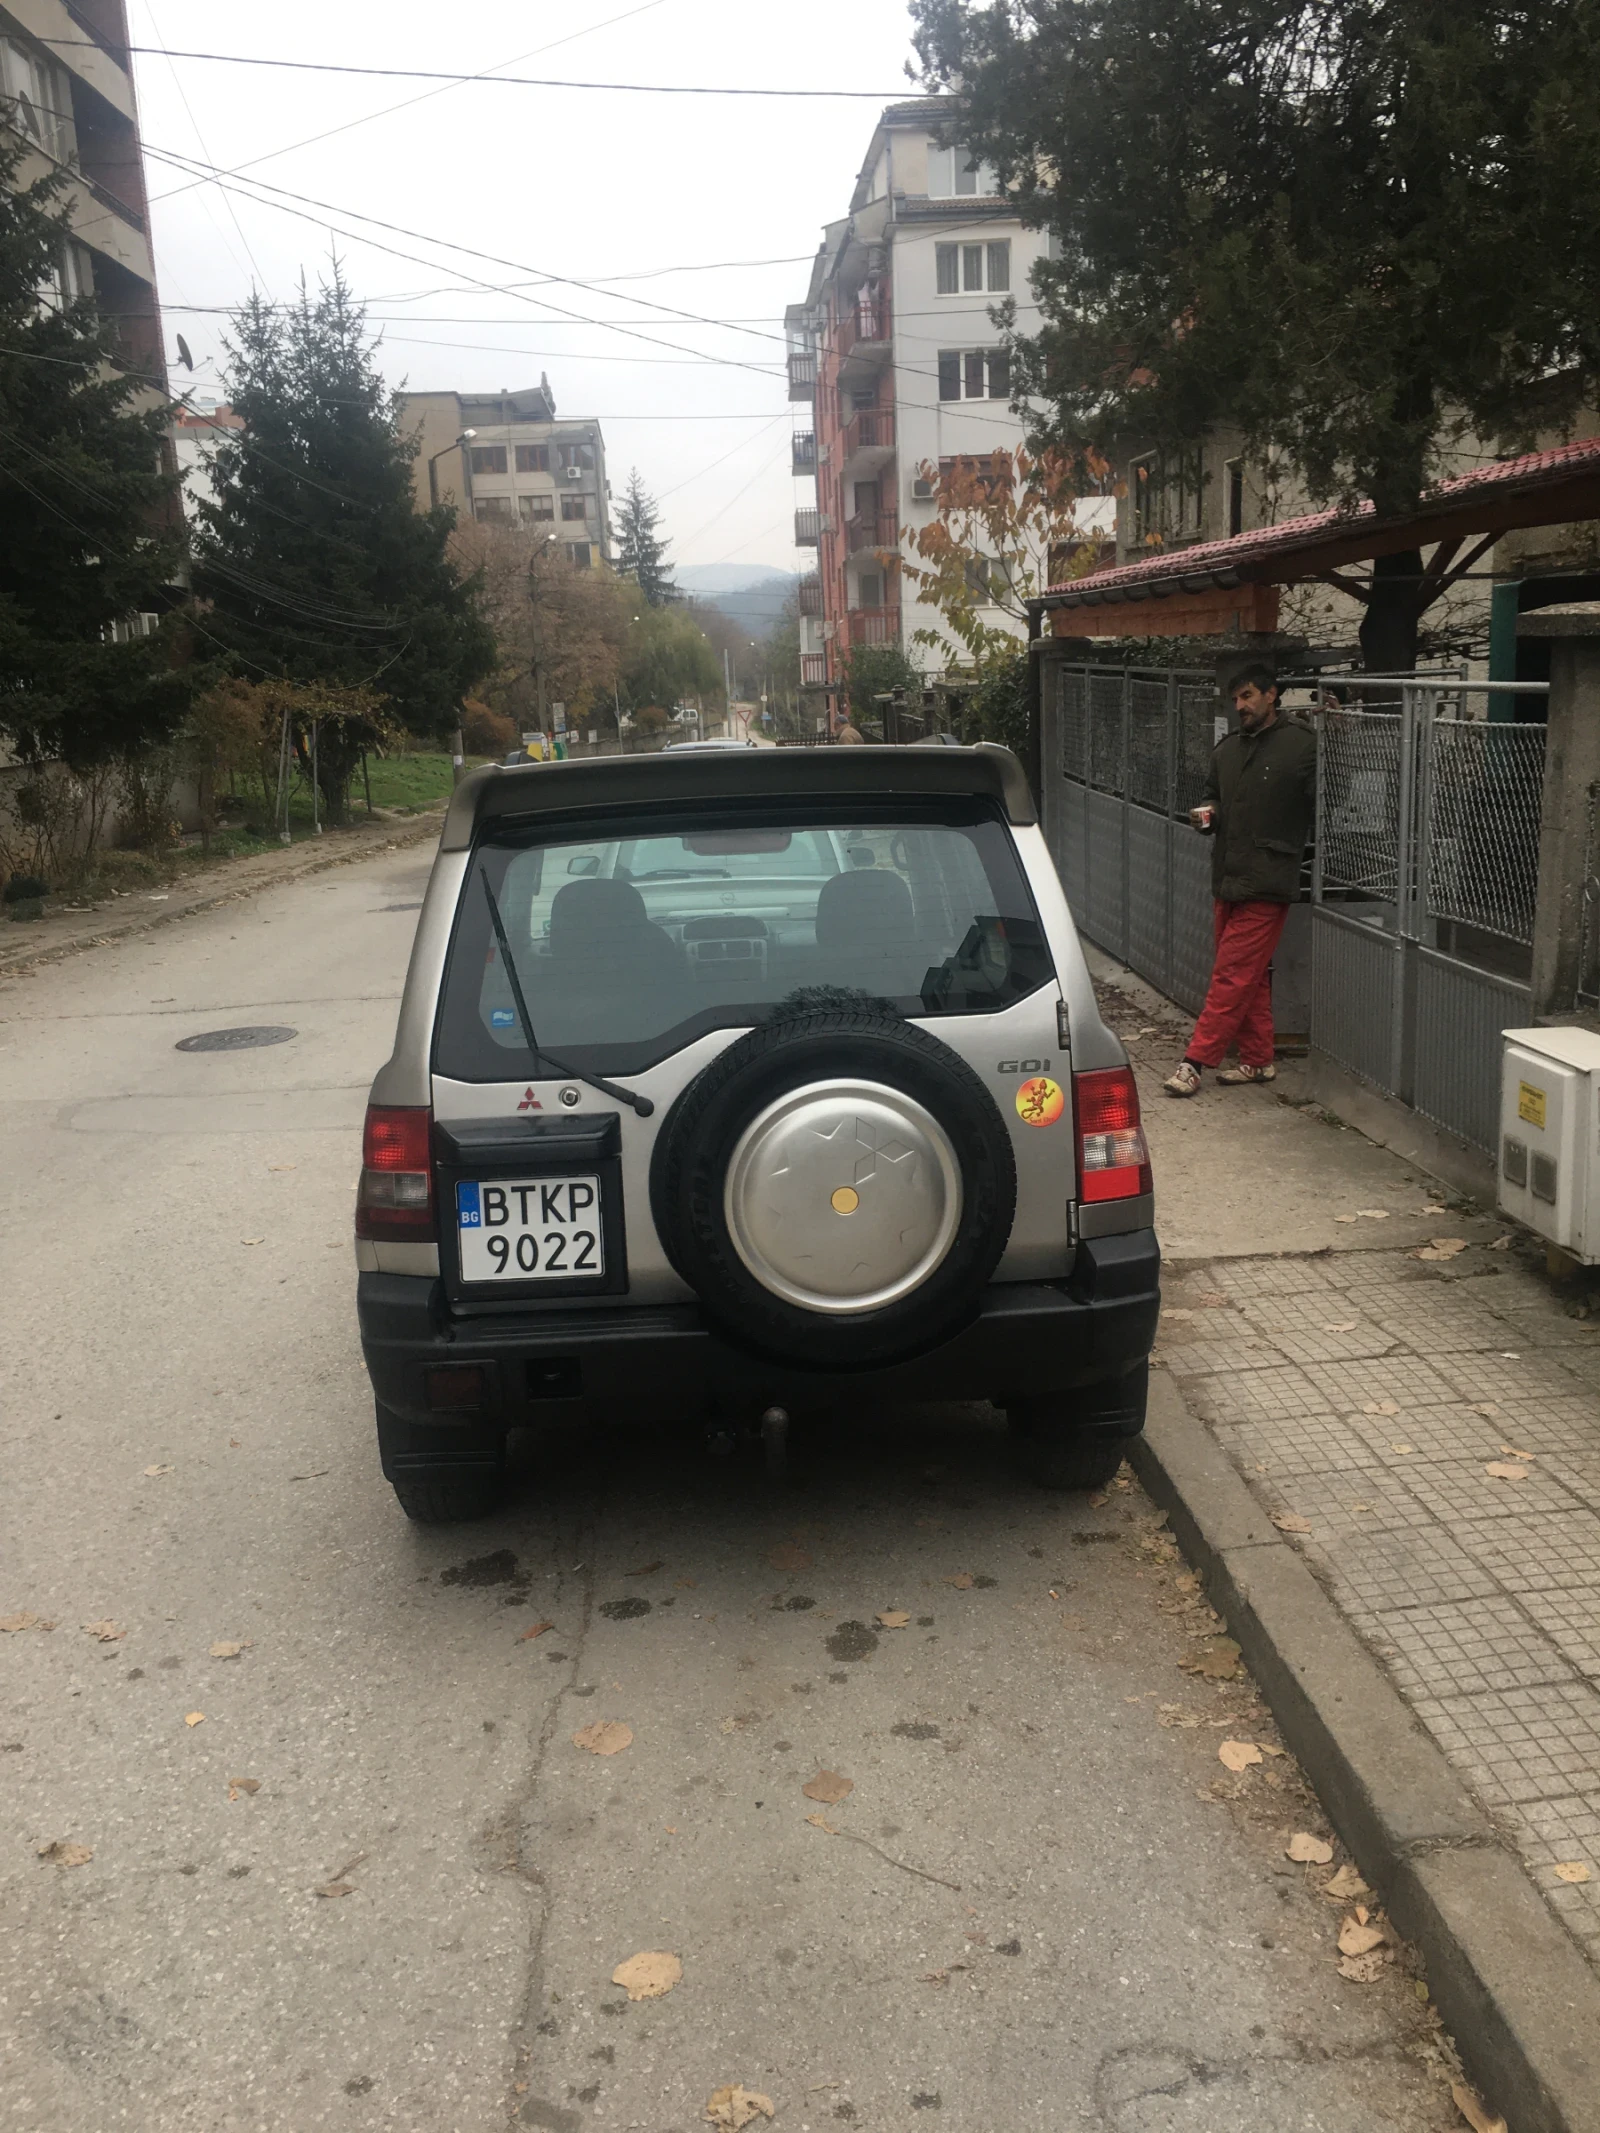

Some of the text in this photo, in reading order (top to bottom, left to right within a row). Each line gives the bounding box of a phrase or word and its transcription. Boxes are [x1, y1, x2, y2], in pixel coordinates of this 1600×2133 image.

[997, 1059, 1051, 1074] GDI
[461, 1211, 479, 1224] BG
[483, 1183, 594, 1227] BTKP
[487, 1230, 597, 1274] 9022
